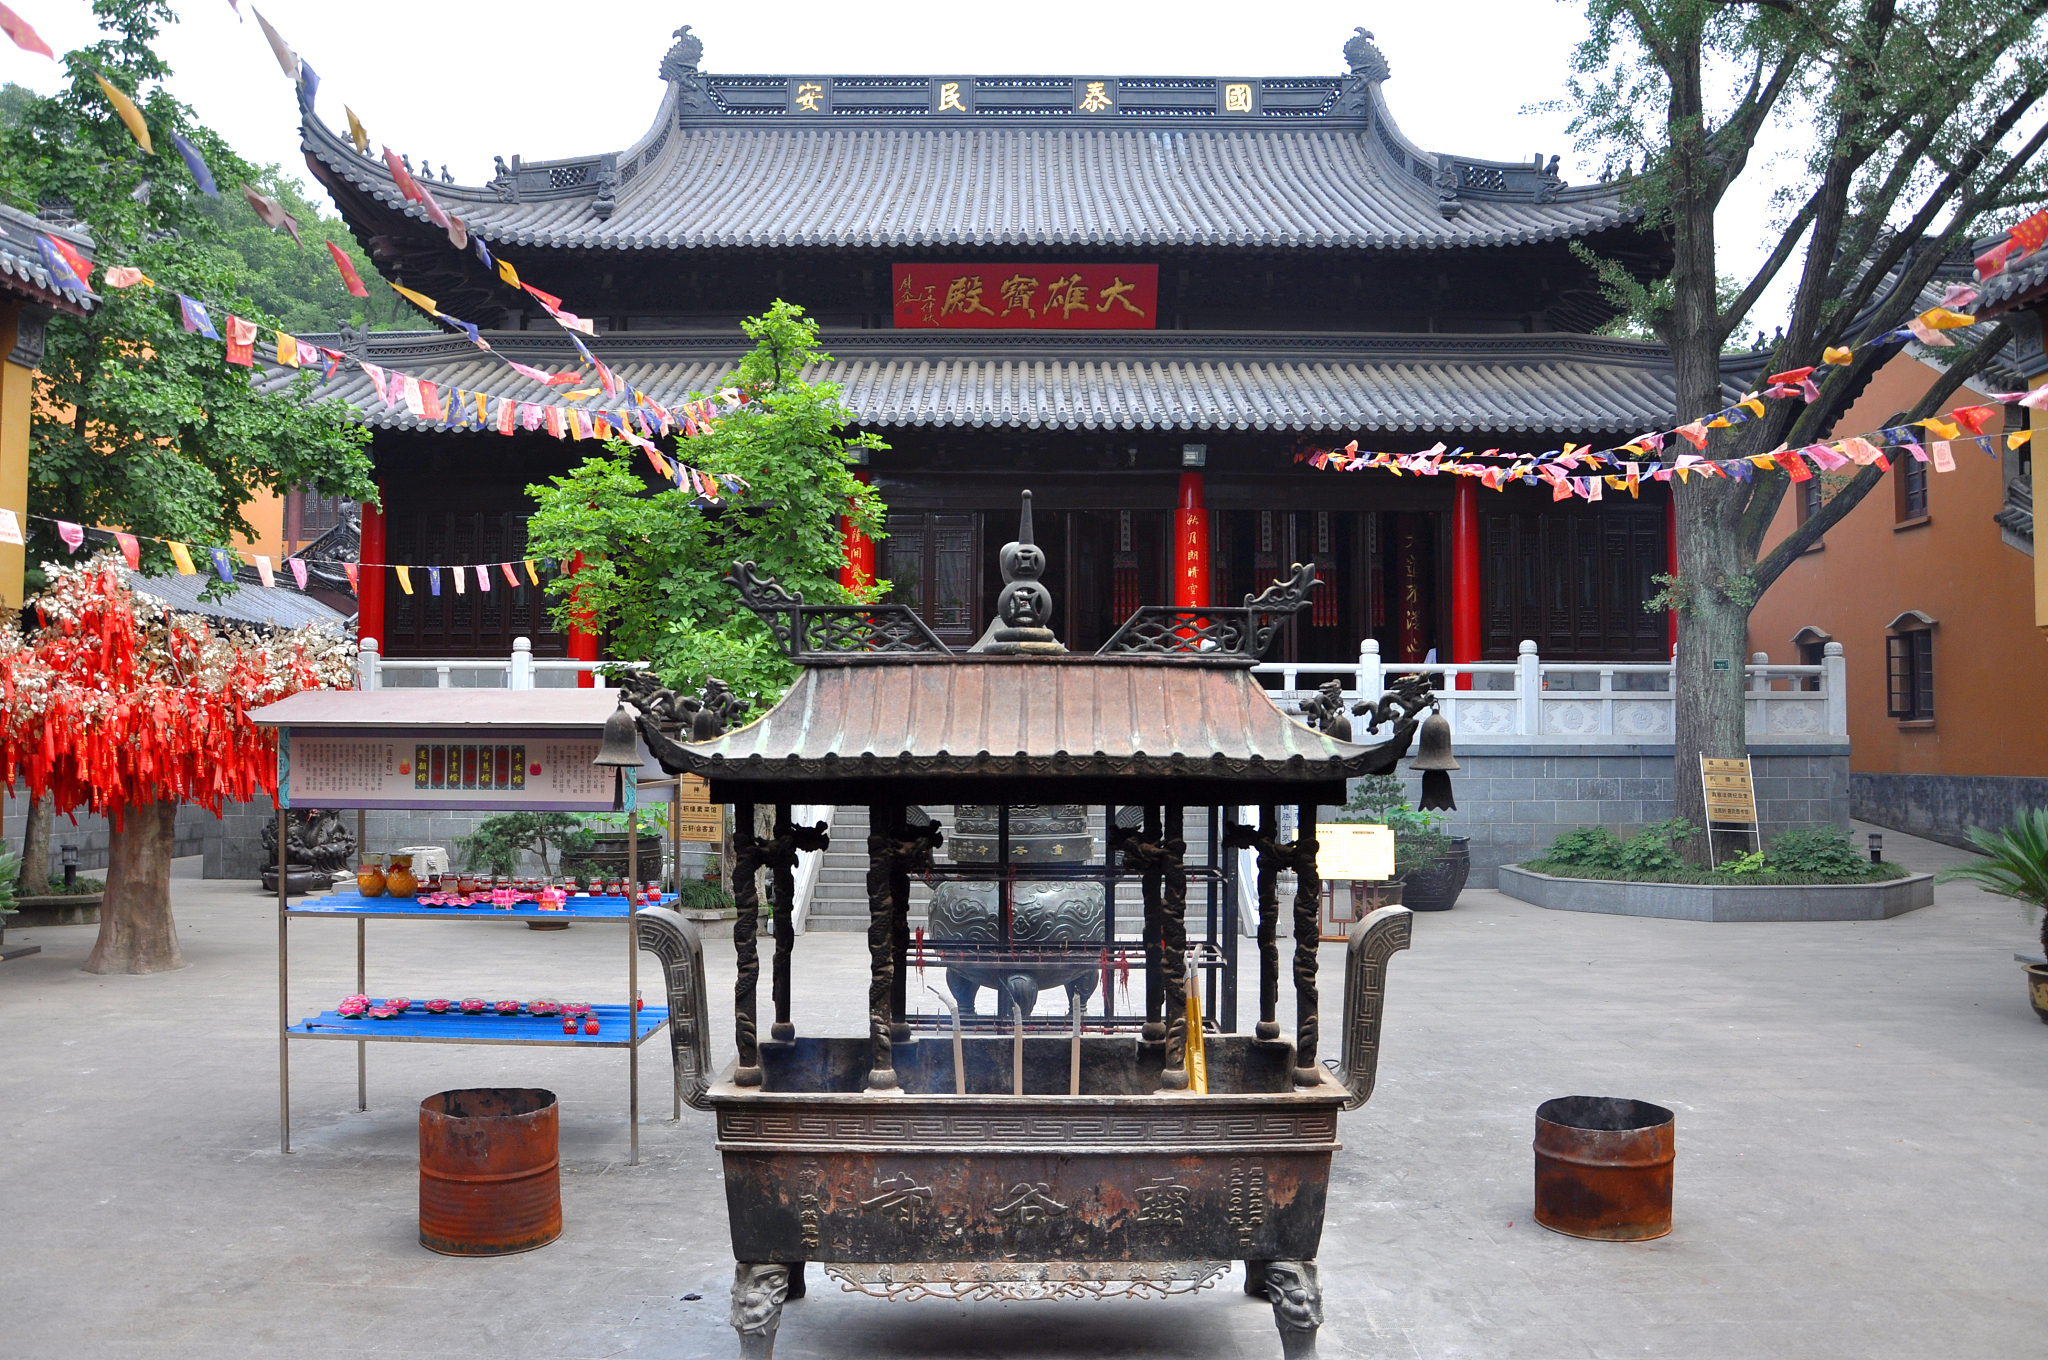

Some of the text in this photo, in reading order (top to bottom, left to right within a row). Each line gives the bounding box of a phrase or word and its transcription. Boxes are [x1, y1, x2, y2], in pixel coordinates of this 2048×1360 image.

[795, 81, 1253, 113] 國泰民安
[940, 273, 1145, 320] 大雄寶殿
[681, 805, 717, 813] 积缘素菜馆
